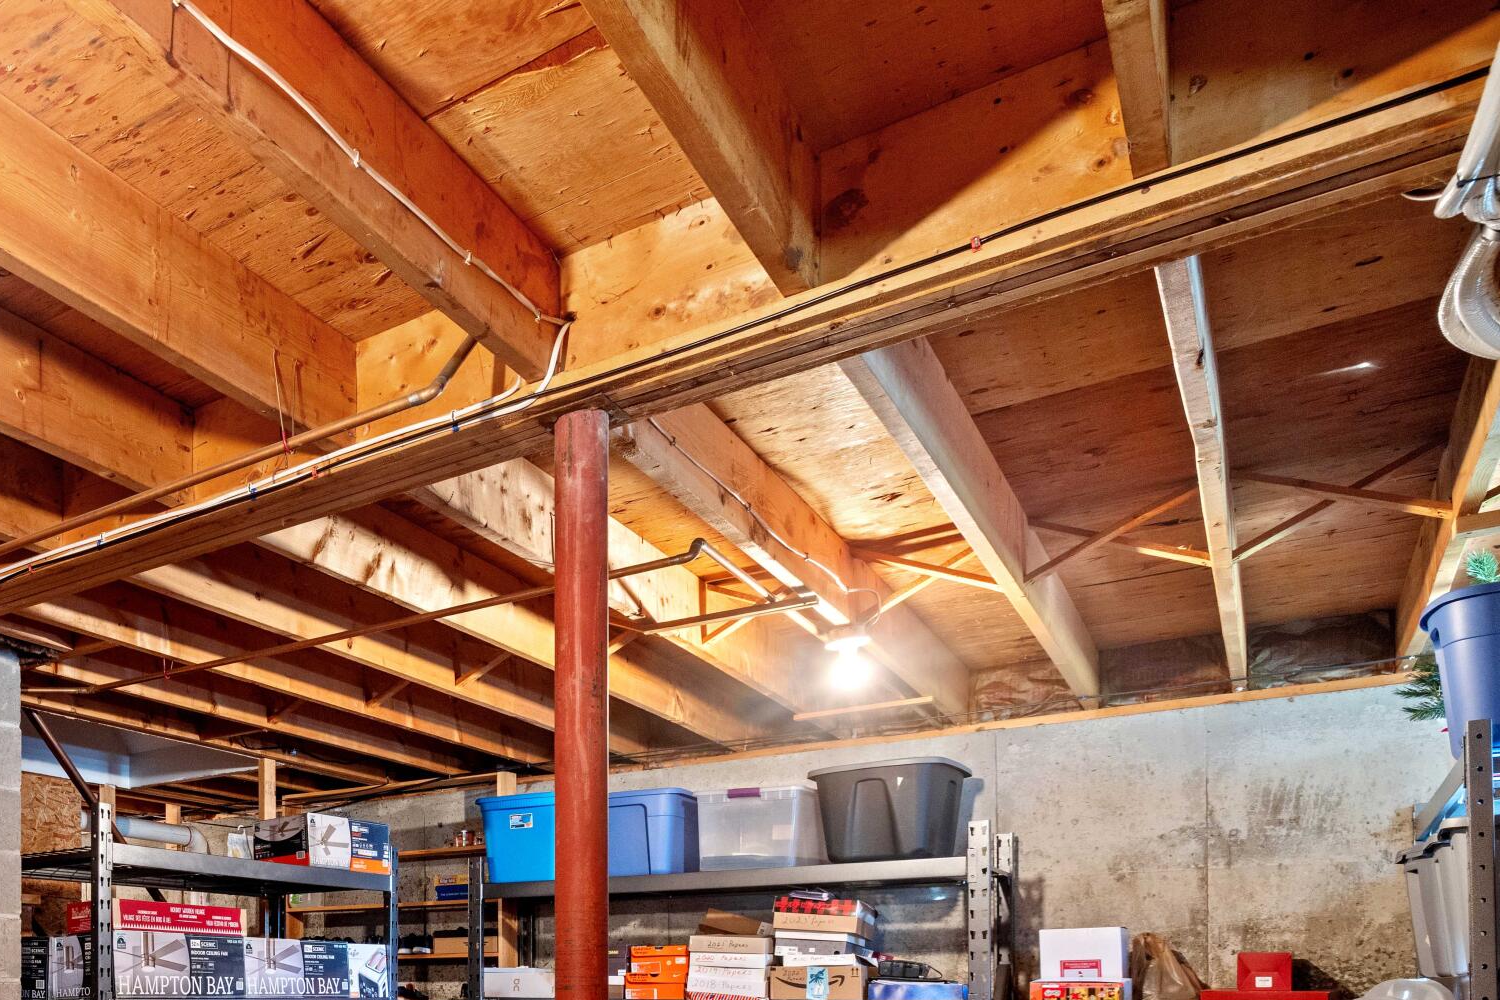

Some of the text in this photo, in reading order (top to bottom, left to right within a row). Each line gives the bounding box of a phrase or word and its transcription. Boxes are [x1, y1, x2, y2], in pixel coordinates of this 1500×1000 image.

[56, 986, 91, 998] HAMPTO
[117, 975, 234, 995] HAMPTON BAY
[247, 977, 341, 995] HAMPTON BAY
[31, 989, 46, 999] BAY
